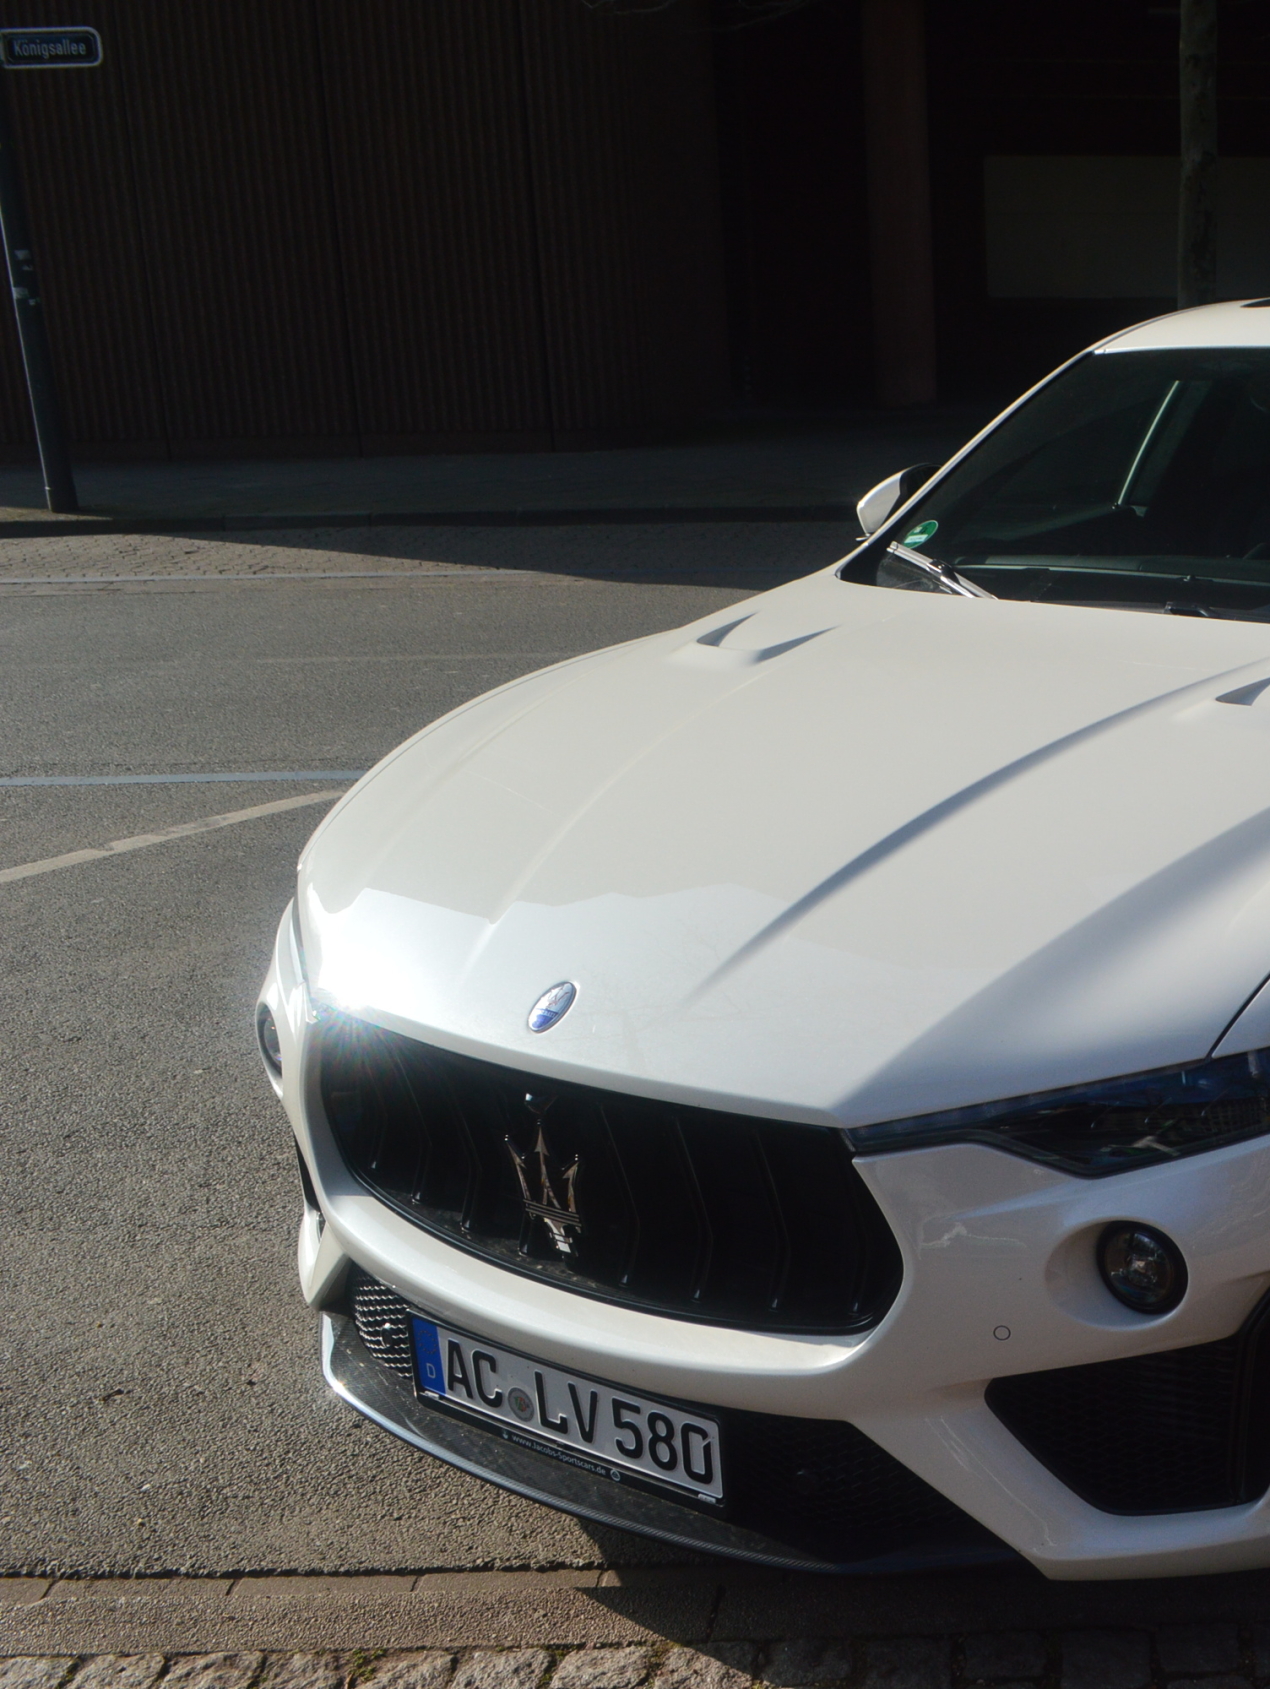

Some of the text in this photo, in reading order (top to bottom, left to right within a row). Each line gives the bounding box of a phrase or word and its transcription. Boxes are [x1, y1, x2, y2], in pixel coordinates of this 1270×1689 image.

[12, 38, 87, 60] Königsallee
[426, 1362, 437, 1379] D
[447, 1338, 713, 1485] AC LV 580
